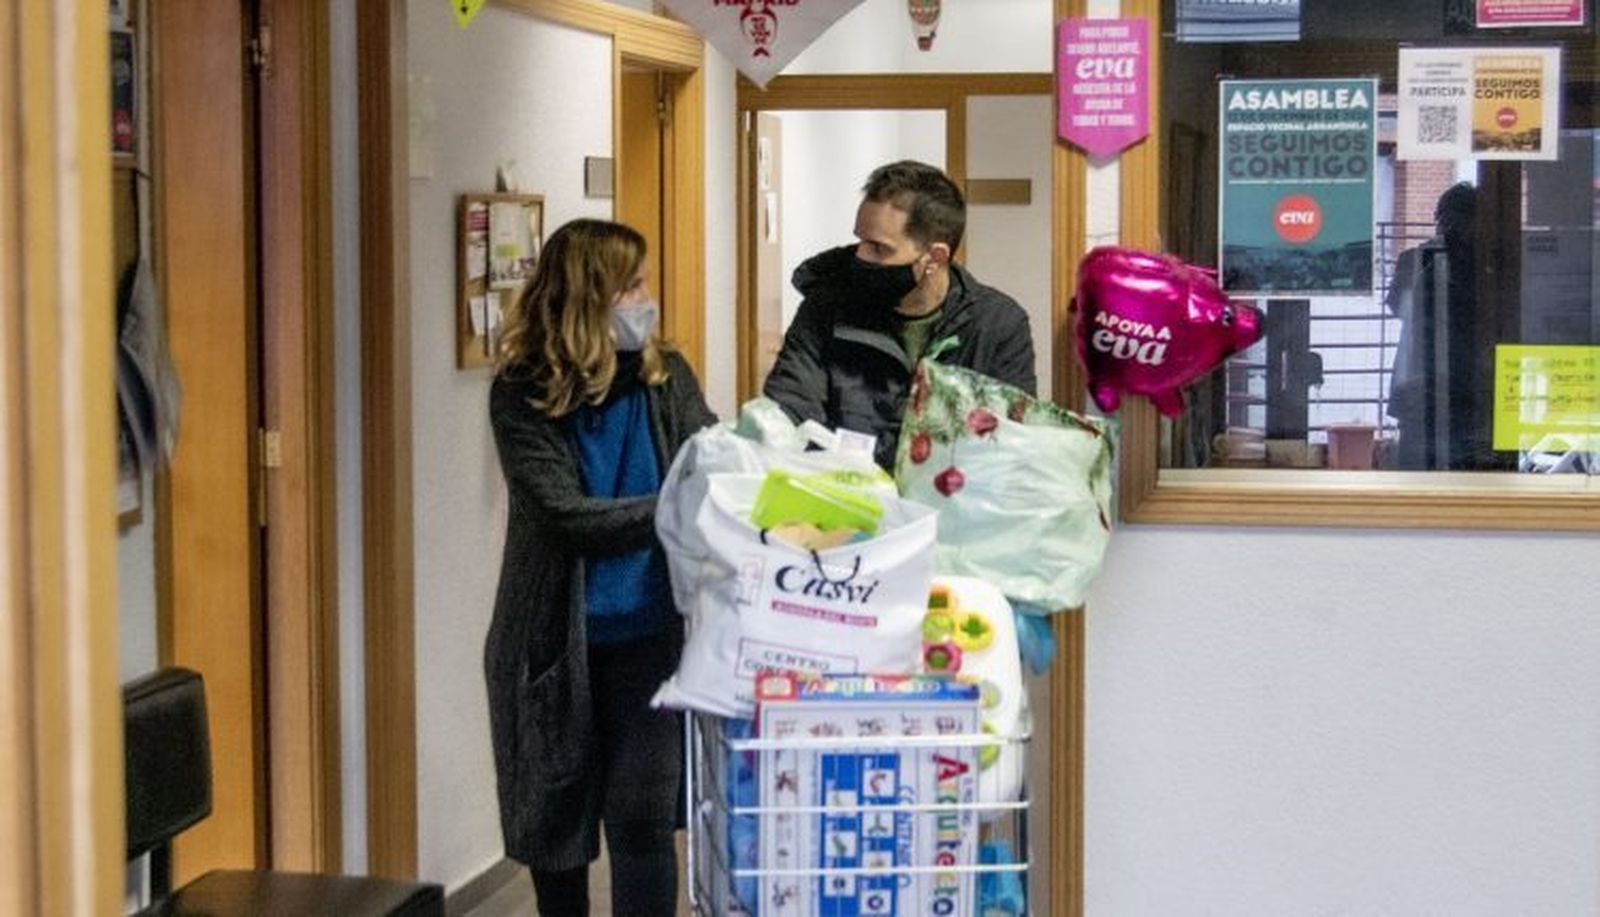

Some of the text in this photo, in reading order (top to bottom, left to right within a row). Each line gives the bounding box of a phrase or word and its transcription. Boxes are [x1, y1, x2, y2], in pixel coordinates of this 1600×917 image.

[1075, 57, 1135, 79] eva
[1474, 77, 1541, 88] SEGUIMOS
[1228, 88, 1369, 111] ASAMBLEA
[1474, 89, 1541, 100] CONTIGO
[1228, 133, 1367, 154] SEGUIMOS
[1228, 155, 1368, 178] CONTIGO
[1279, 211, 1315, 225] eva
[1095, 310, 1155, 339] APOYA
[1092, 329, 1168, 366] eva
[763, 650, 831, 671] CENTRO
